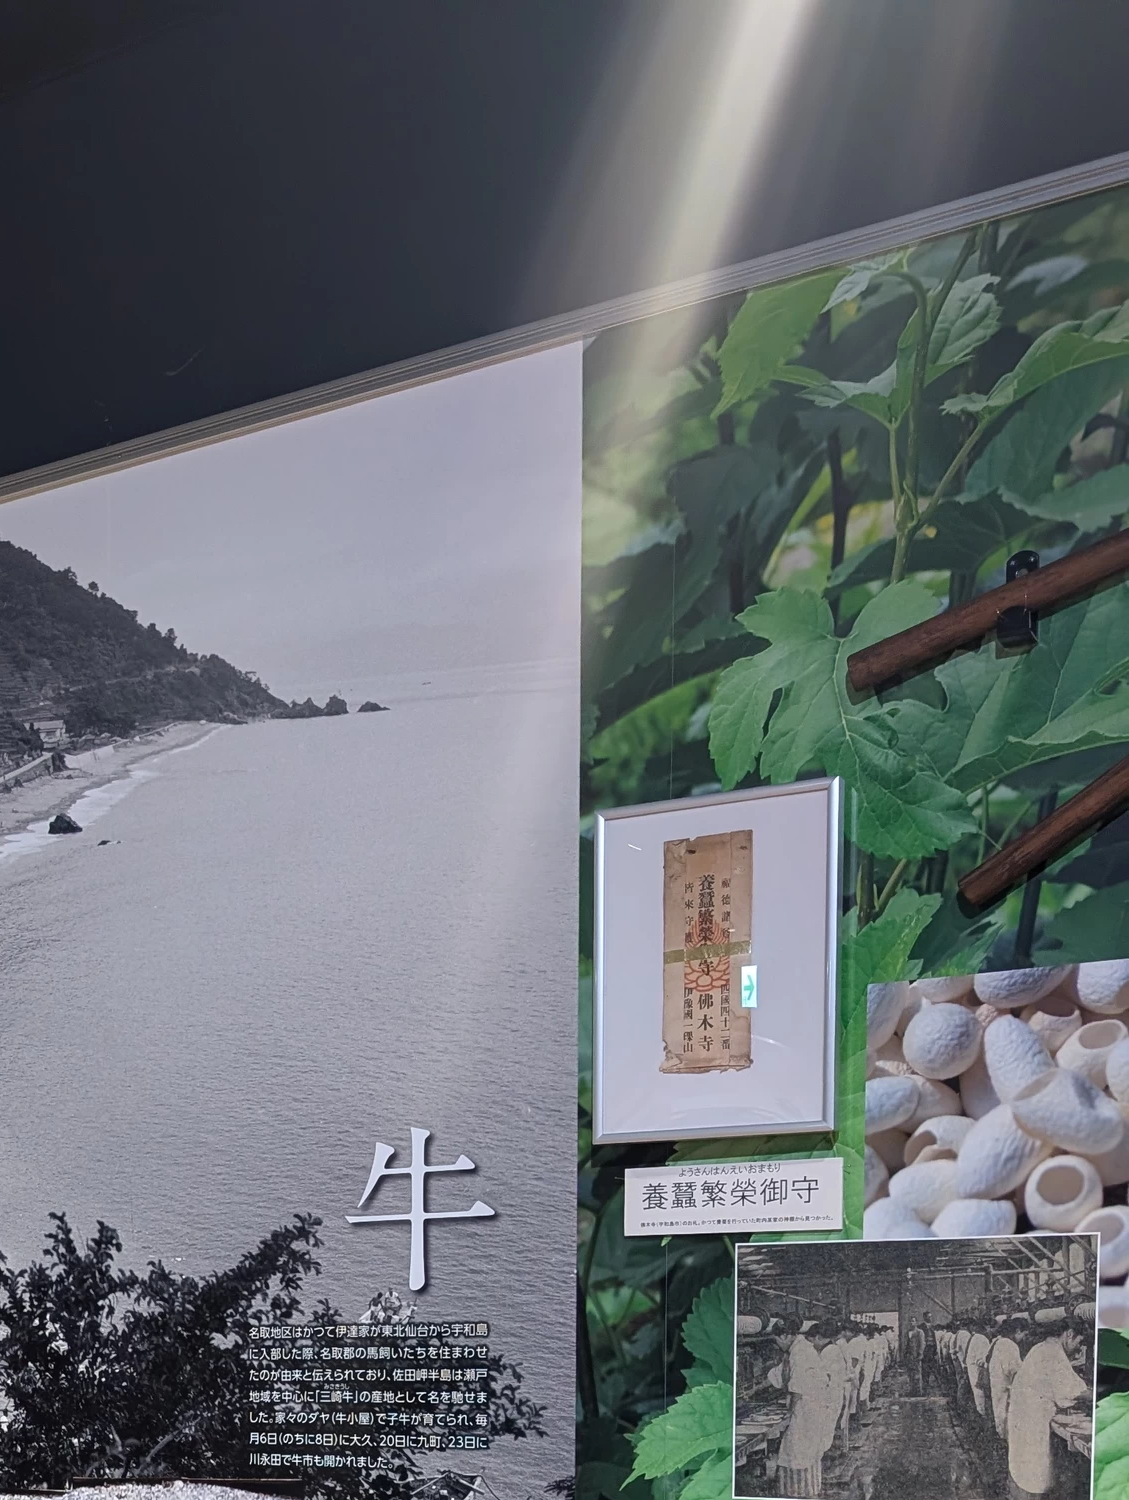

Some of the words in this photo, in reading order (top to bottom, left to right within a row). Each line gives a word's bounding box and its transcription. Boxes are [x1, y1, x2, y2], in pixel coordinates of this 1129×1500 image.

[697, 993, 715, 1052] 佛木寺
[678, 1163, 781, 1178] ようさんはんえいおまもり
[344, 1127, 496, 1291] 牛
[249, 1323, 488, 1339] 名取地区はかつて伊達家が東北仙台から宇和島
[249, 1346, 487, 1361] に入部した際、名取郡の馬飼いたちを住まわせ
[249, 1368, 488, 1382] たのが由来と伝えられており、佐田岬半島は瀬戸
[249, 1390, 487, 1404] 地域を中心に「三崎牛」の産地として名を馳せま
[249, 1453, 394, 1469] 川永田で牛市も開かれました。
